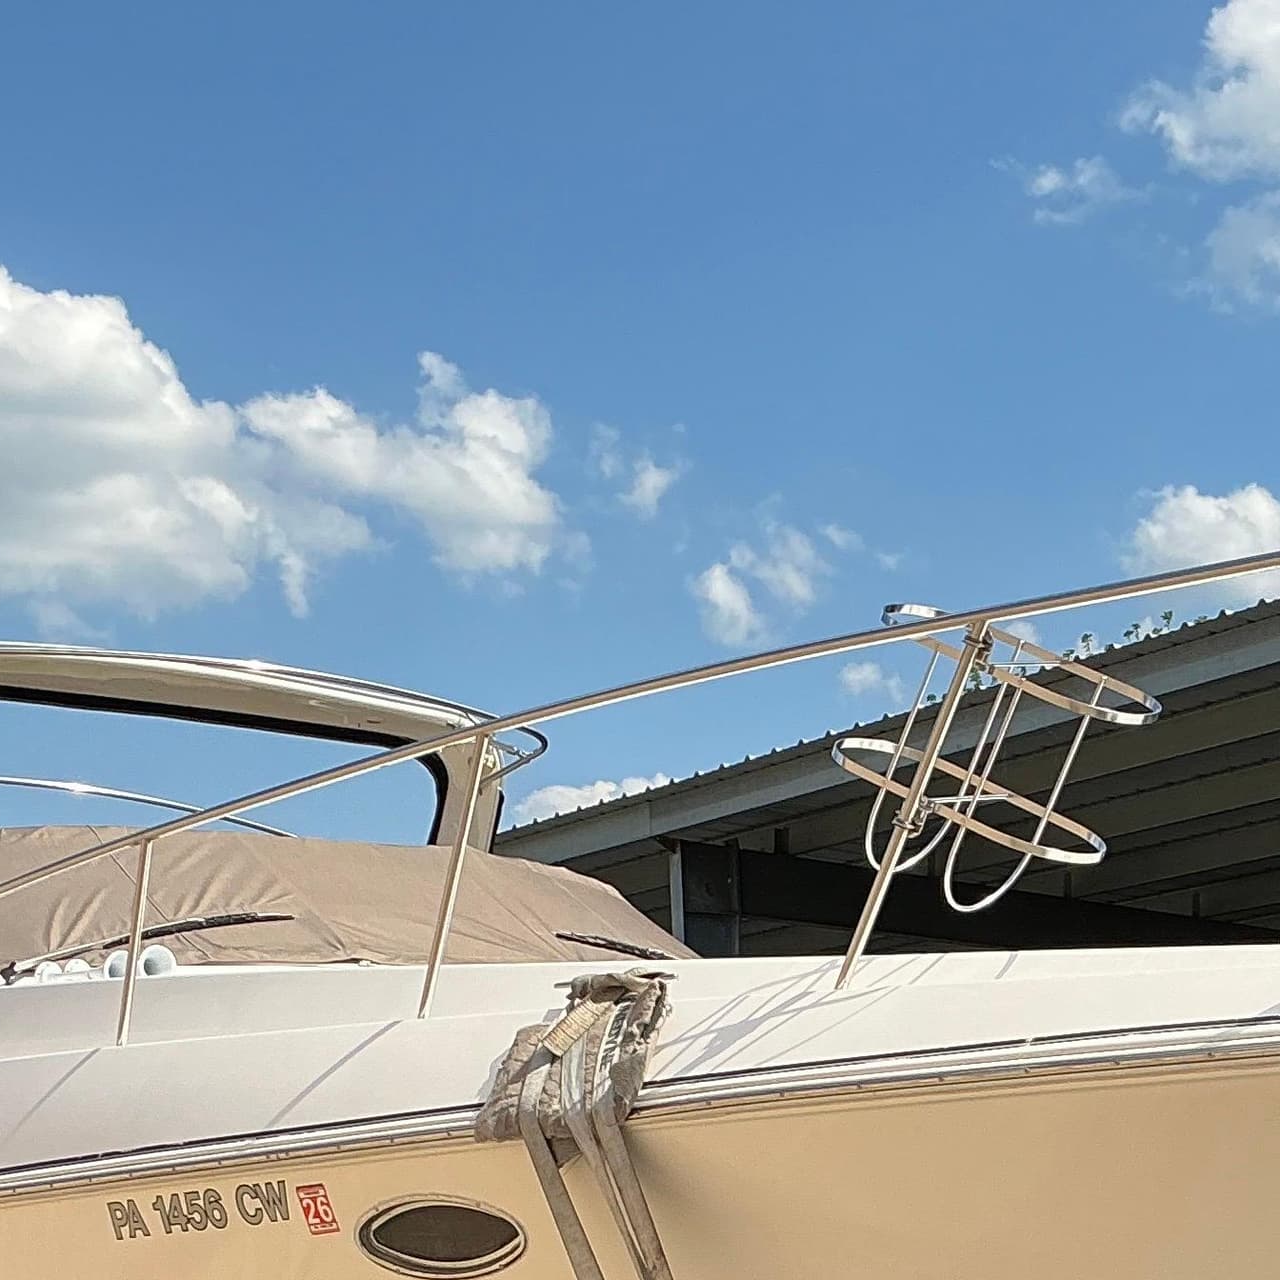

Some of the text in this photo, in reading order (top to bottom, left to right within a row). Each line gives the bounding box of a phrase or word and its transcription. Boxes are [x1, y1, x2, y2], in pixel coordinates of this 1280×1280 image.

[106, 1180, 290, 1240] PA 1456 CW
[303, 1196, 333, 1224] 26
